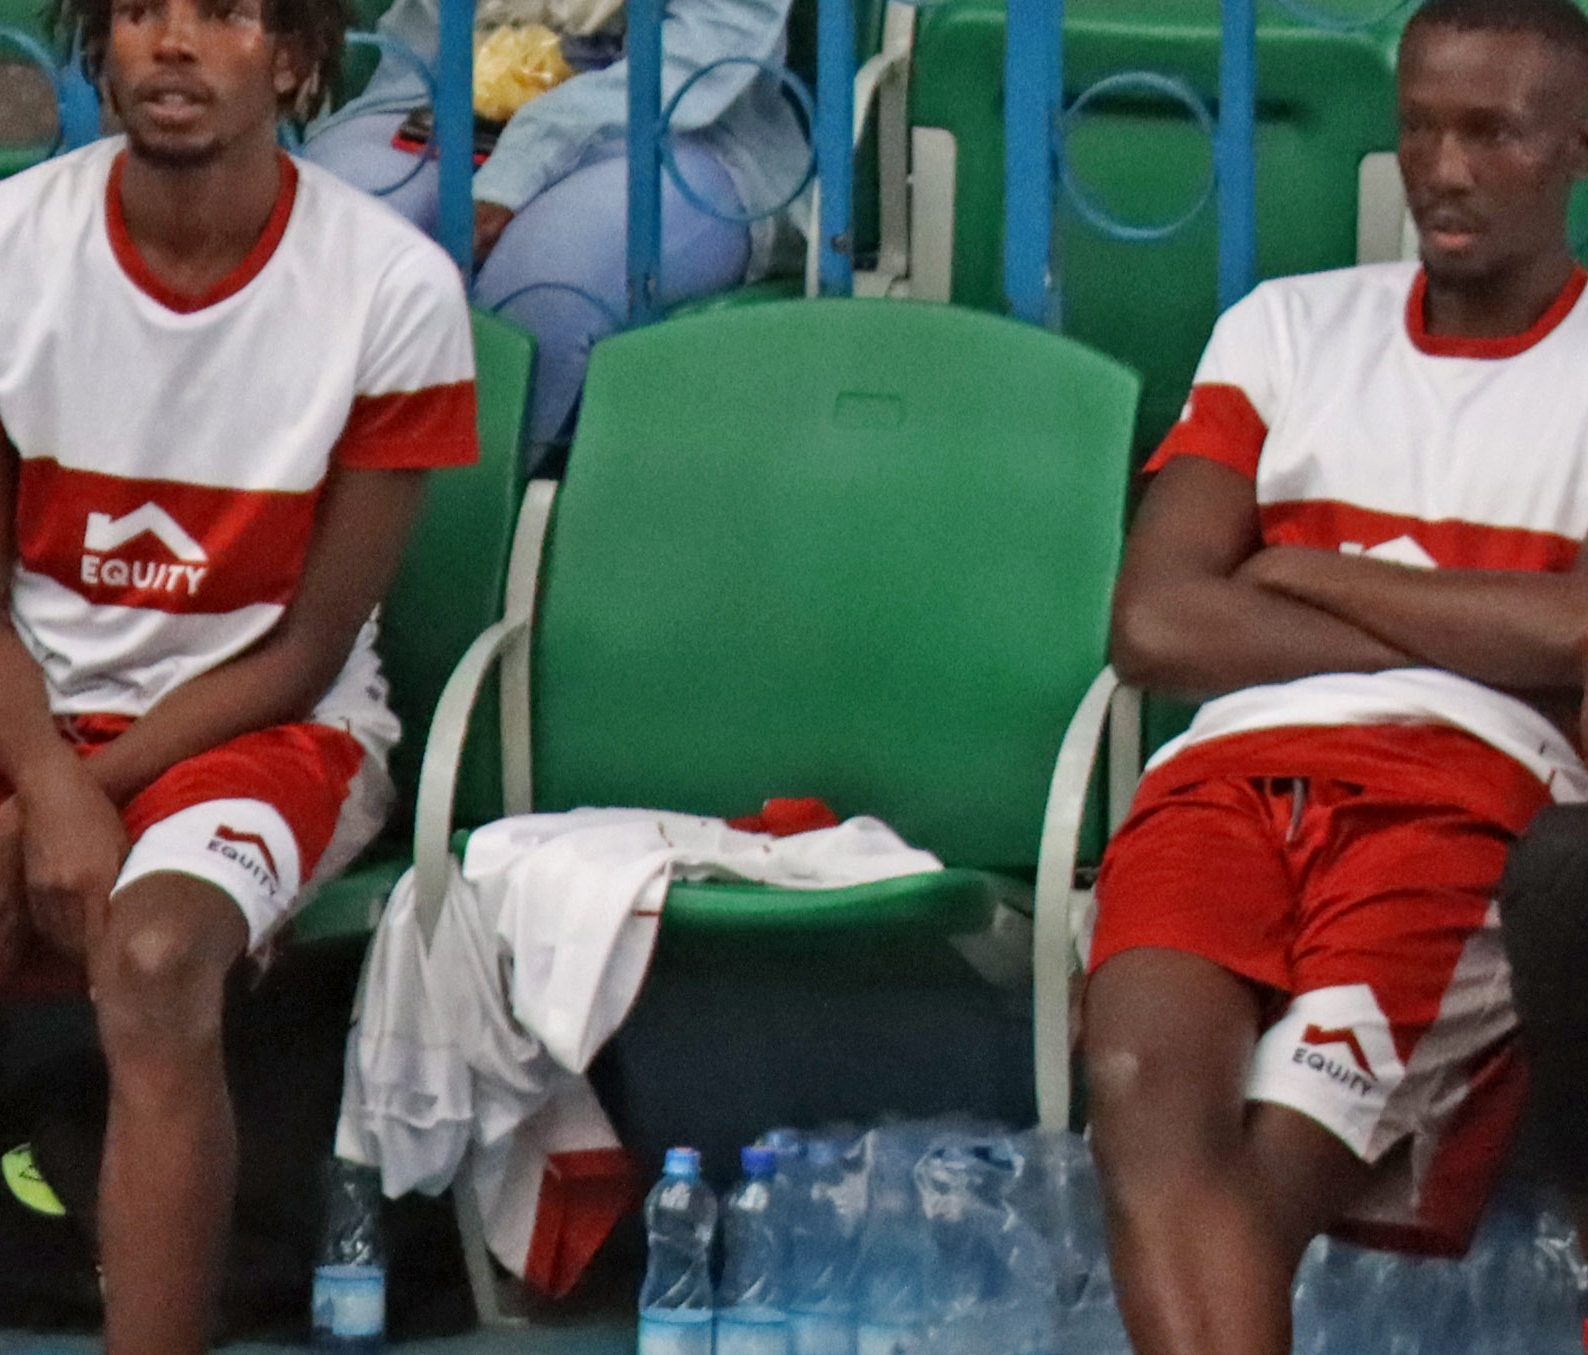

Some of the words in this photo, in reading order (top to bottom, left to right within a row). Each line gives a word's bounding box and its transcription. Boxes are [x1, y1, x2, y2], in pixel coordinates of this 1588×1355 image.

[81, 554, 208, 596] EQUITY
[207, 840, 278, 896] EQUITY
[1292, 1047, 1372, 1096] EQUITY
